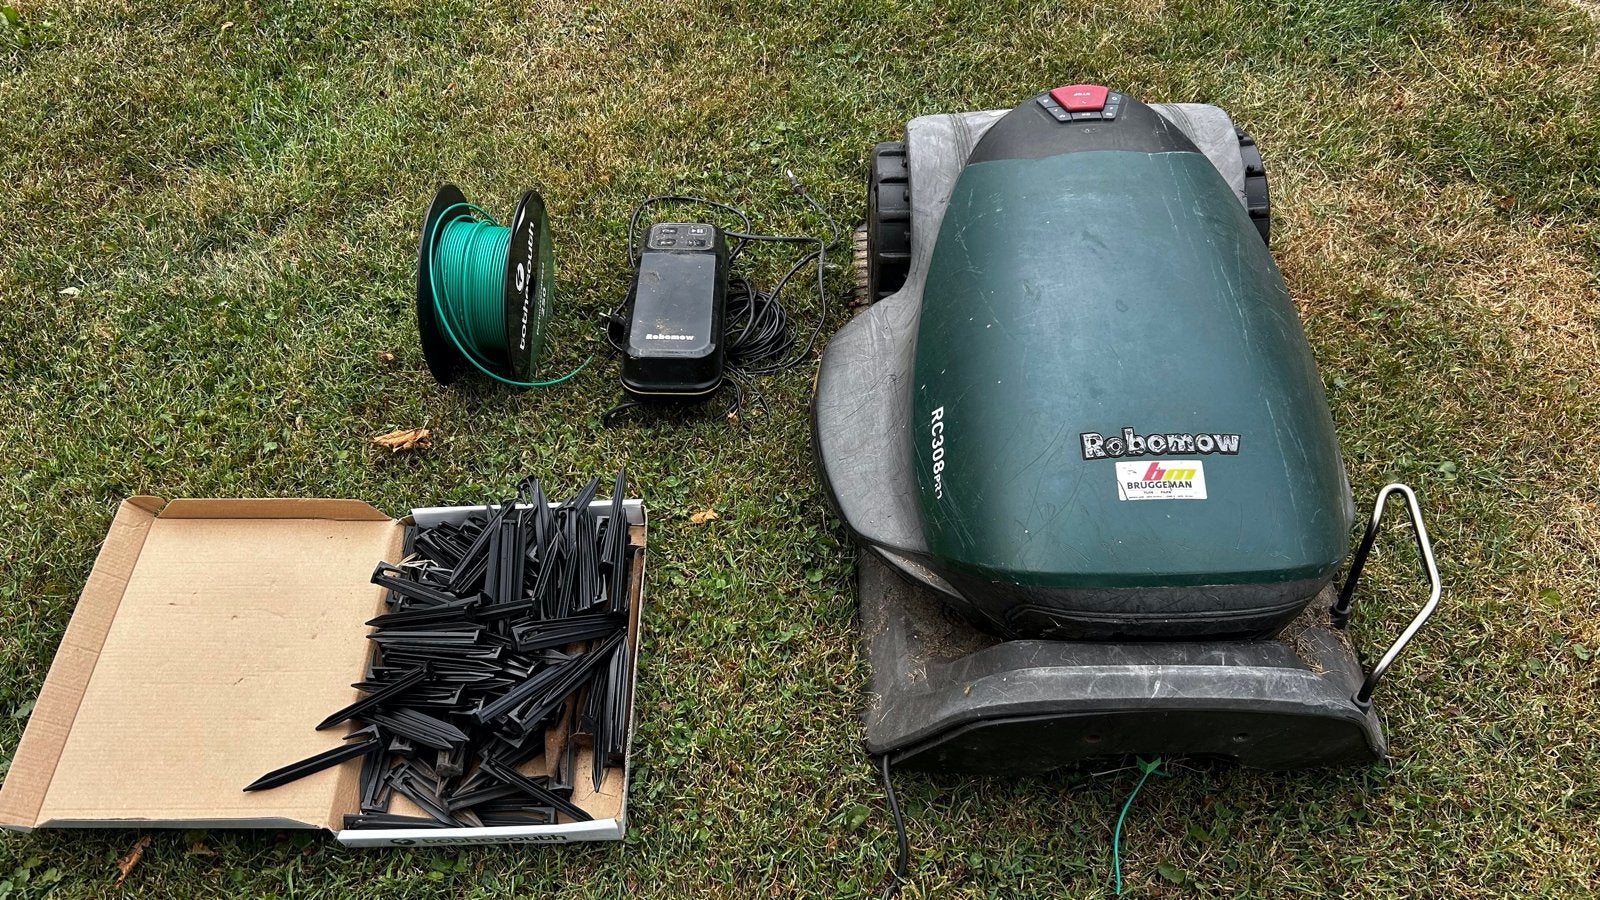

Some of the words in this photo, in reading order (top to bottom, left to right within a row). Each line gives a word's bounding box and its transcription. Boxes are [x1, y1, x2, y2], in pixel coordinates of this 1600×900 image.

[645, 333, 695, 341] Robomow
[1080, 427, 1241, 460] Robomow
[1127, 480, 1192, 490] BRUGGEMAN
